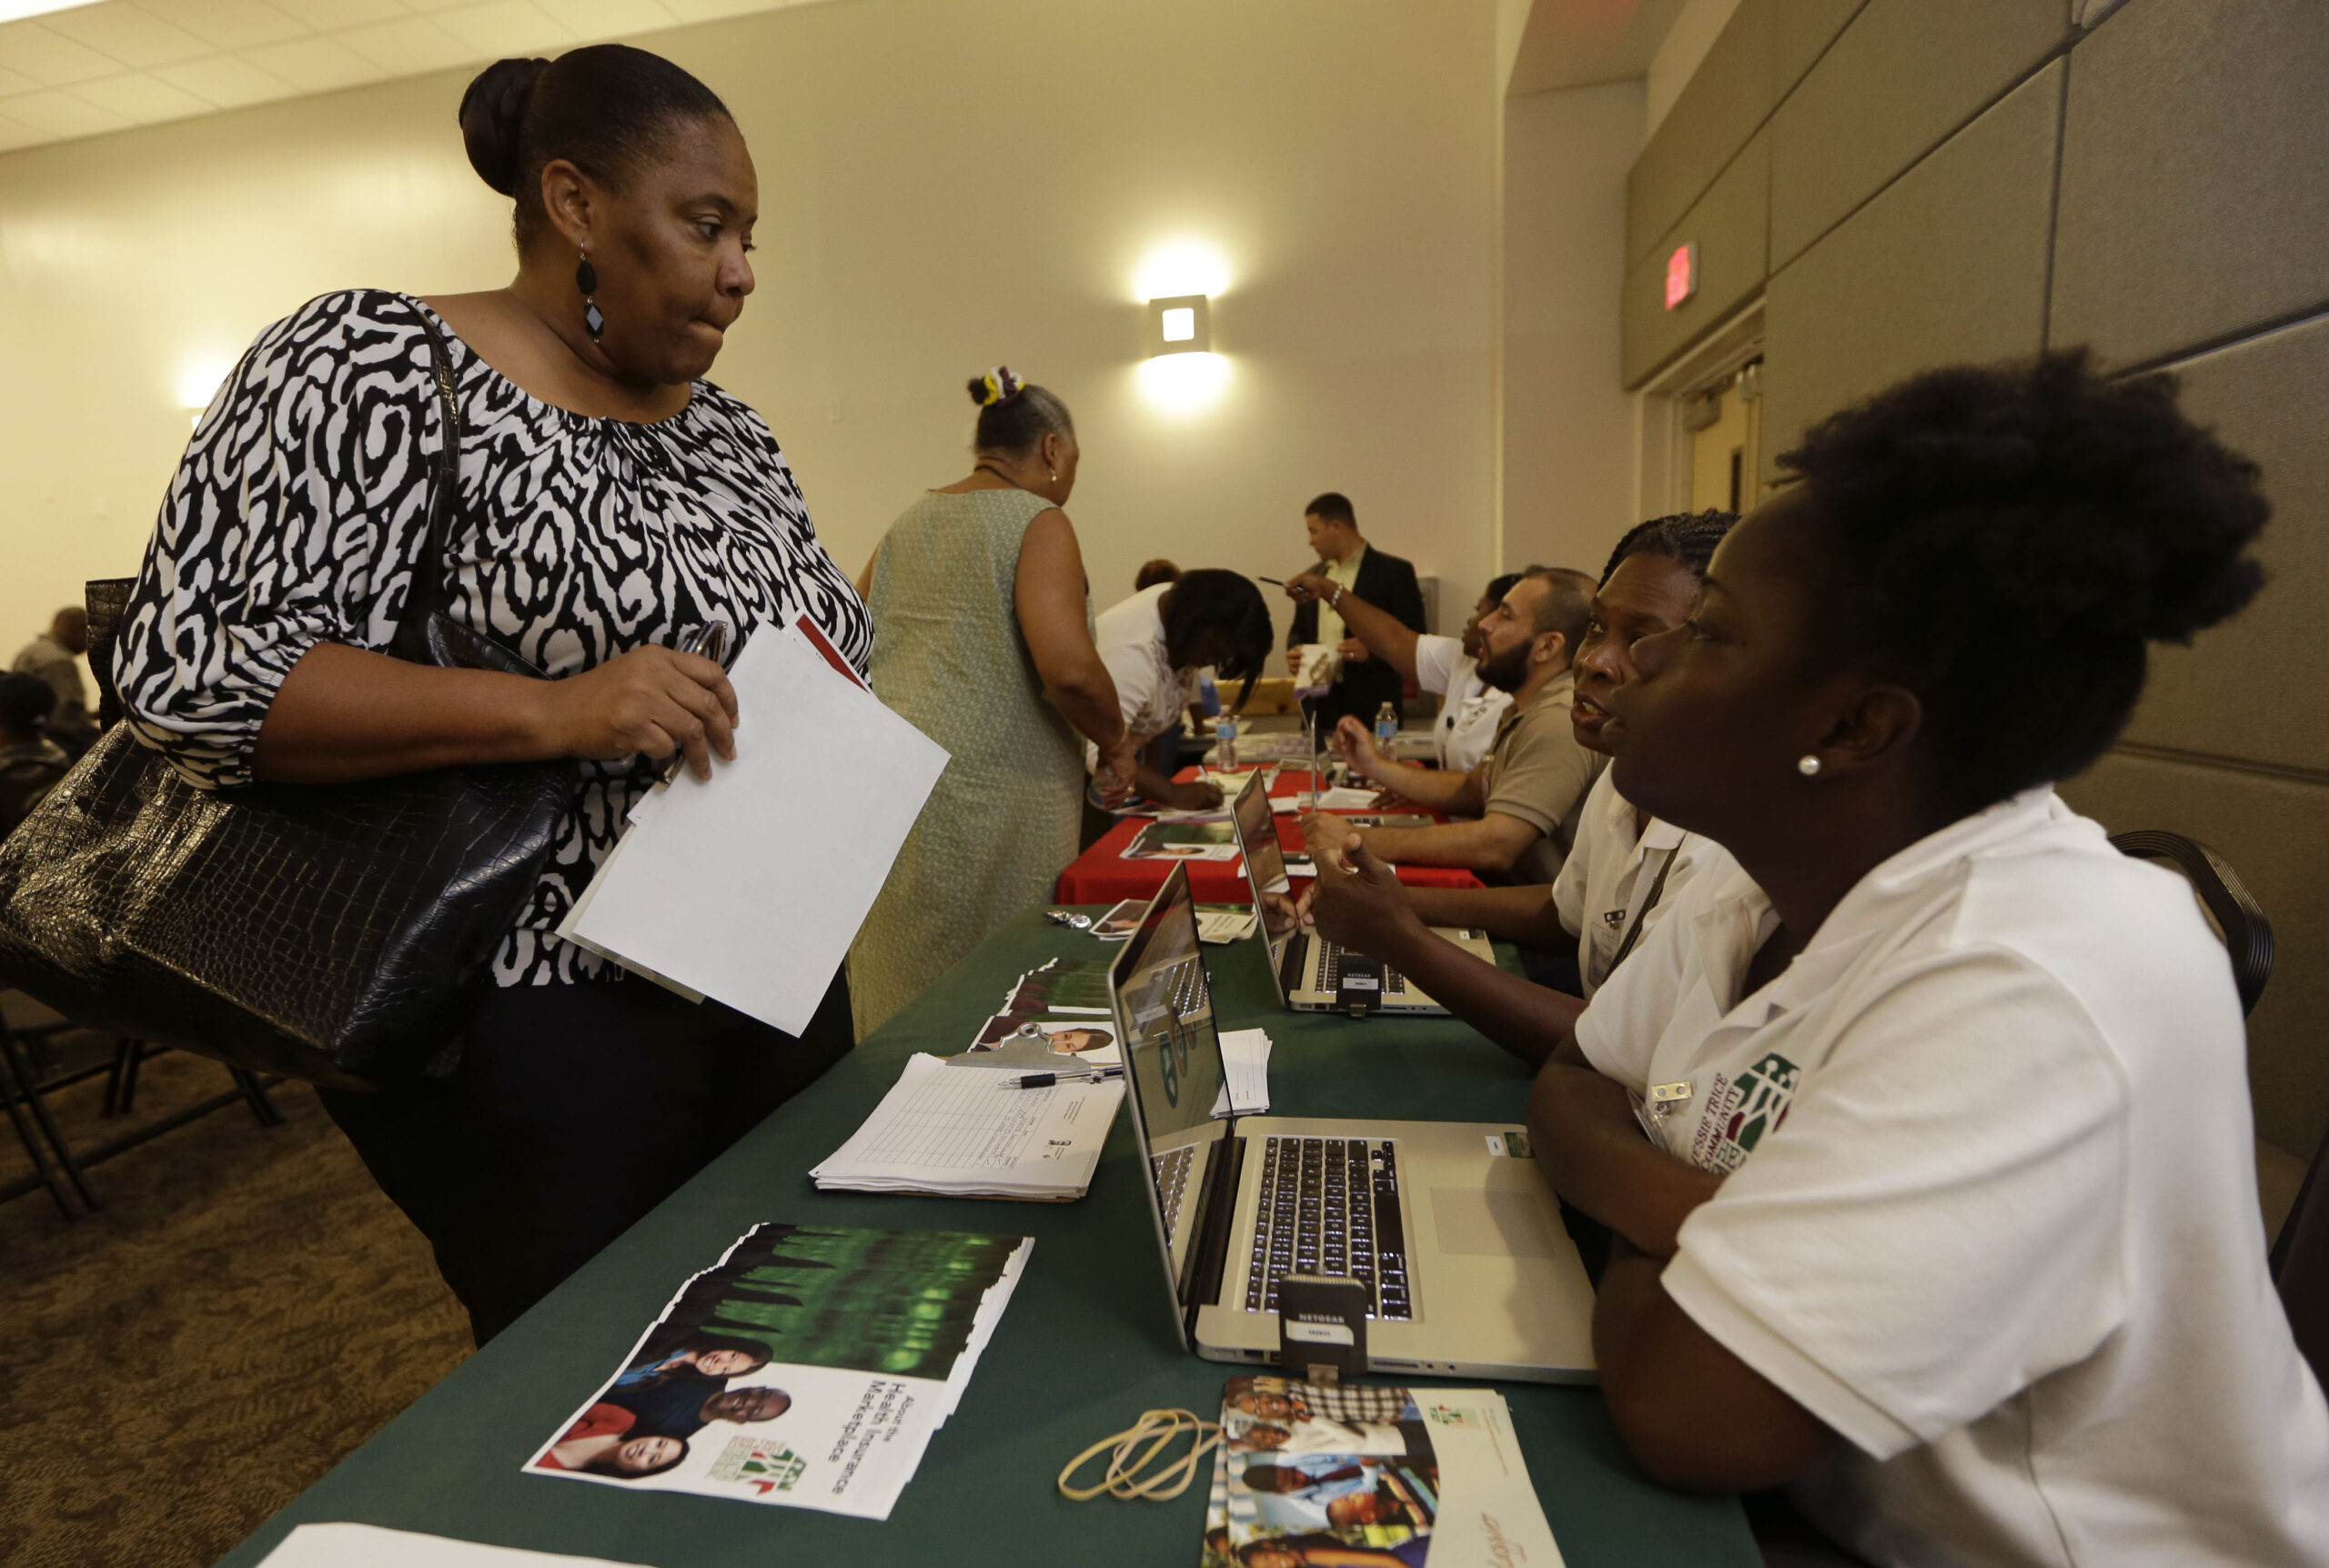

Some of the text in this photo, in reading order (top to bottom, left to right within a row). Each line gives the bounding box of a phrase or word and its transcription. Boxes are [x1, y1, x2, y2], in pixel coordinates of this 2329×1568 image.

[1691, 1072, 1729, 1168] JESSIE TRICE
[1700, 1087, 1739, 1171] COMMUNITY
[1299, 1312, 1345, 1324] NETGEAR
[828, 1380, 887, 1462] Marketplace
[832, 1382, 906, 1494] Health Insurance
